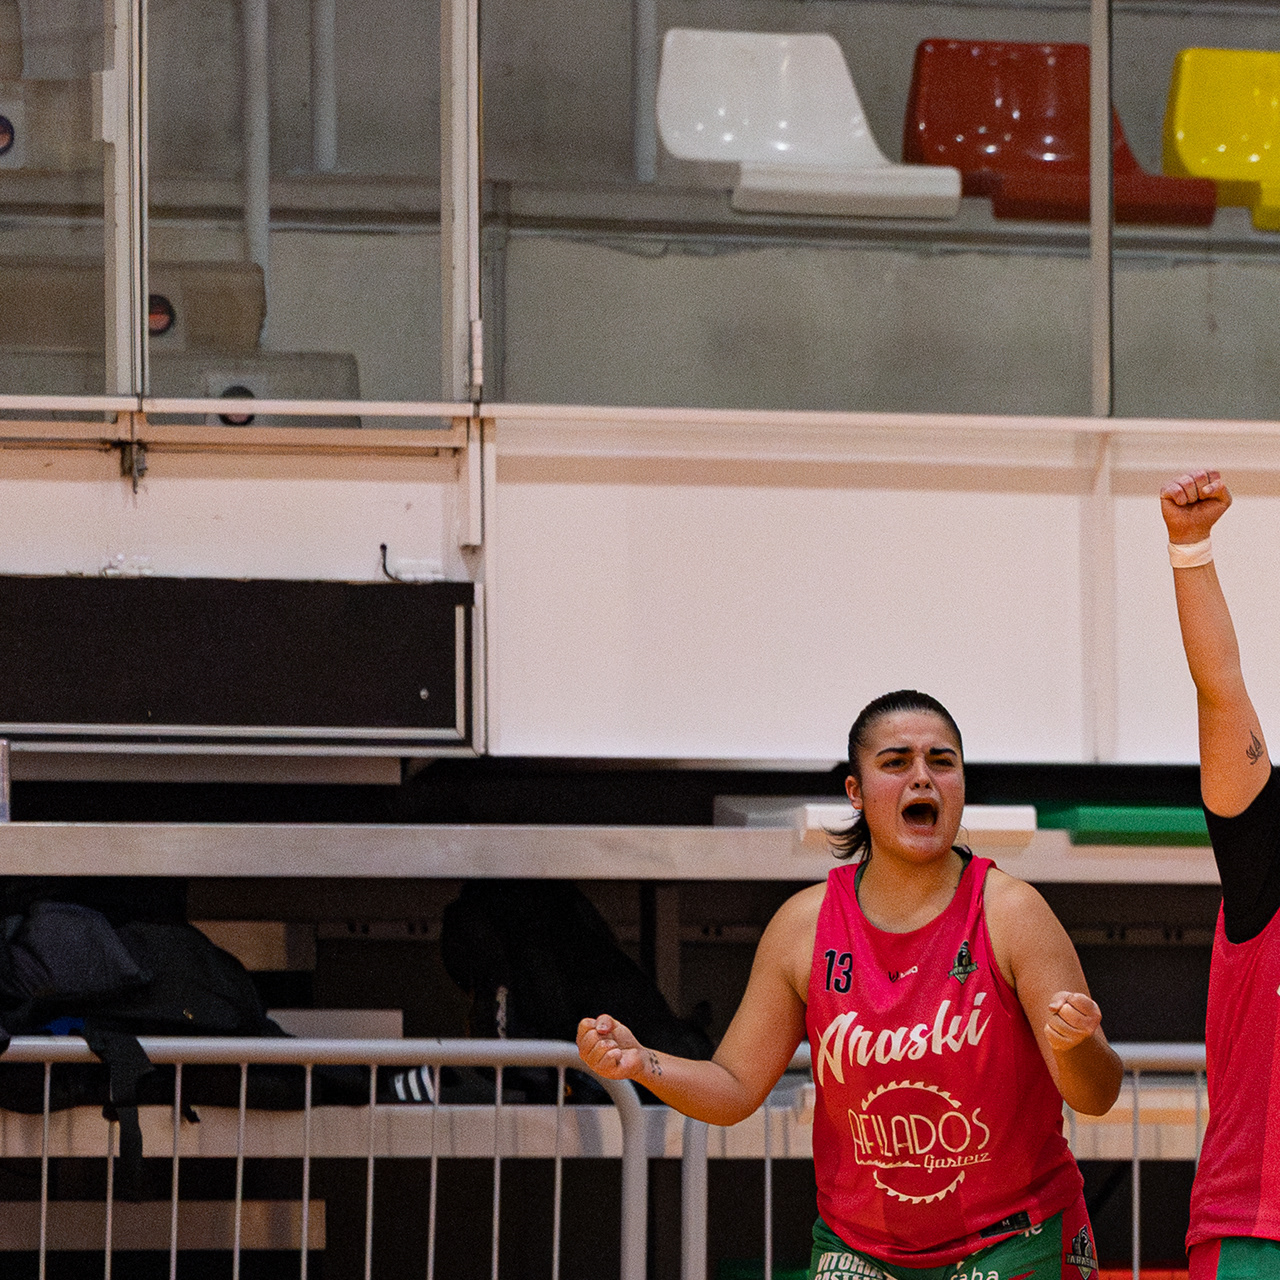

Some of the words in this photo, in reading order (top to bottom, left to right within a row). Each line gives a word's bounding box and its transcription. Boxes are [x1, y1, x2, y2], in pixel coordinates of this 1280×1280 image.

[825, 949, 853, 994] 13
[815, 992, 992, 1087] Araski
[848, 1107, 991, 1157] AFILADOS
